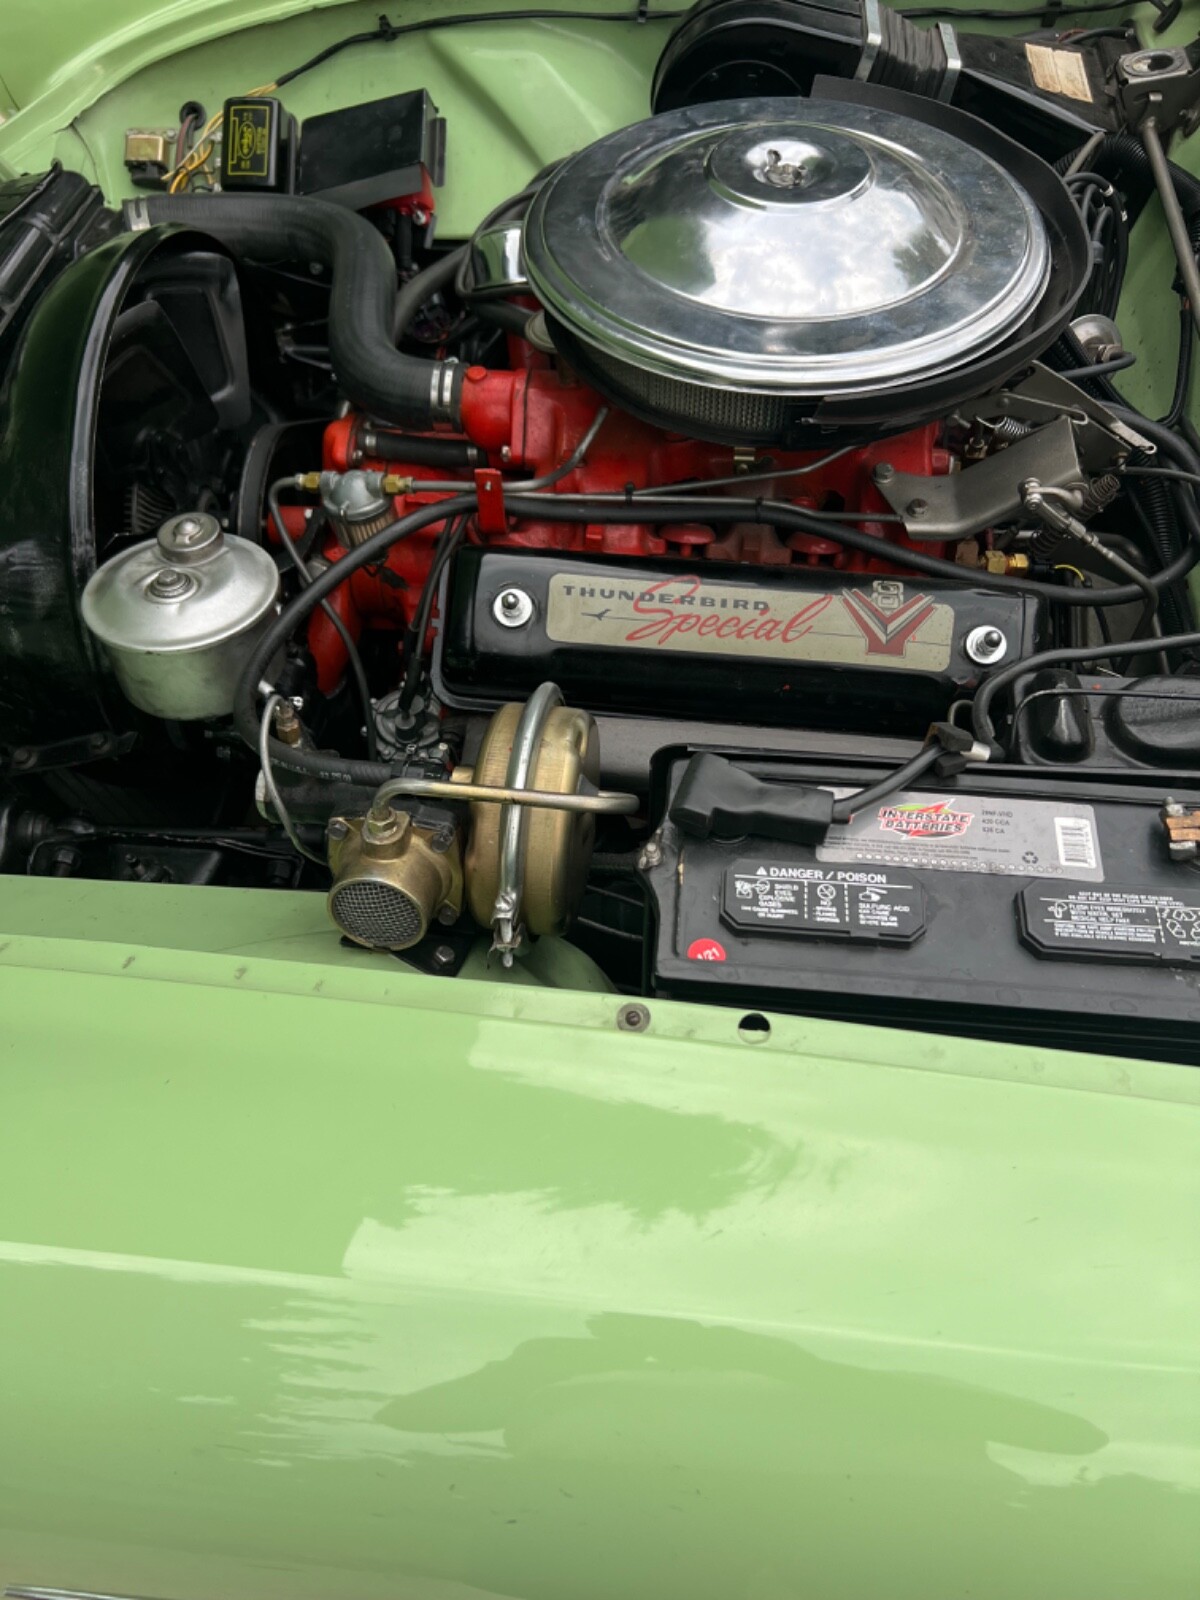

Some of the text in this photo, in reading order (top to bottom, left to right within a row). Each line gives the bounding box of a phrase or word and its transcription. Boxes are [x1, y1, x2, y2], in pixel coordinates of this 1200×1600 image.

[563, 585, 769, 611] THUNDERBIRD
[625, 574, 833, 645] Special
[882, 809, 969, 823] INTERSTATE
[885, 820, 962, 832] BATTERIES
[769, 867, 823, 880] DANGER
[837, 871, 887, 884] POISON
